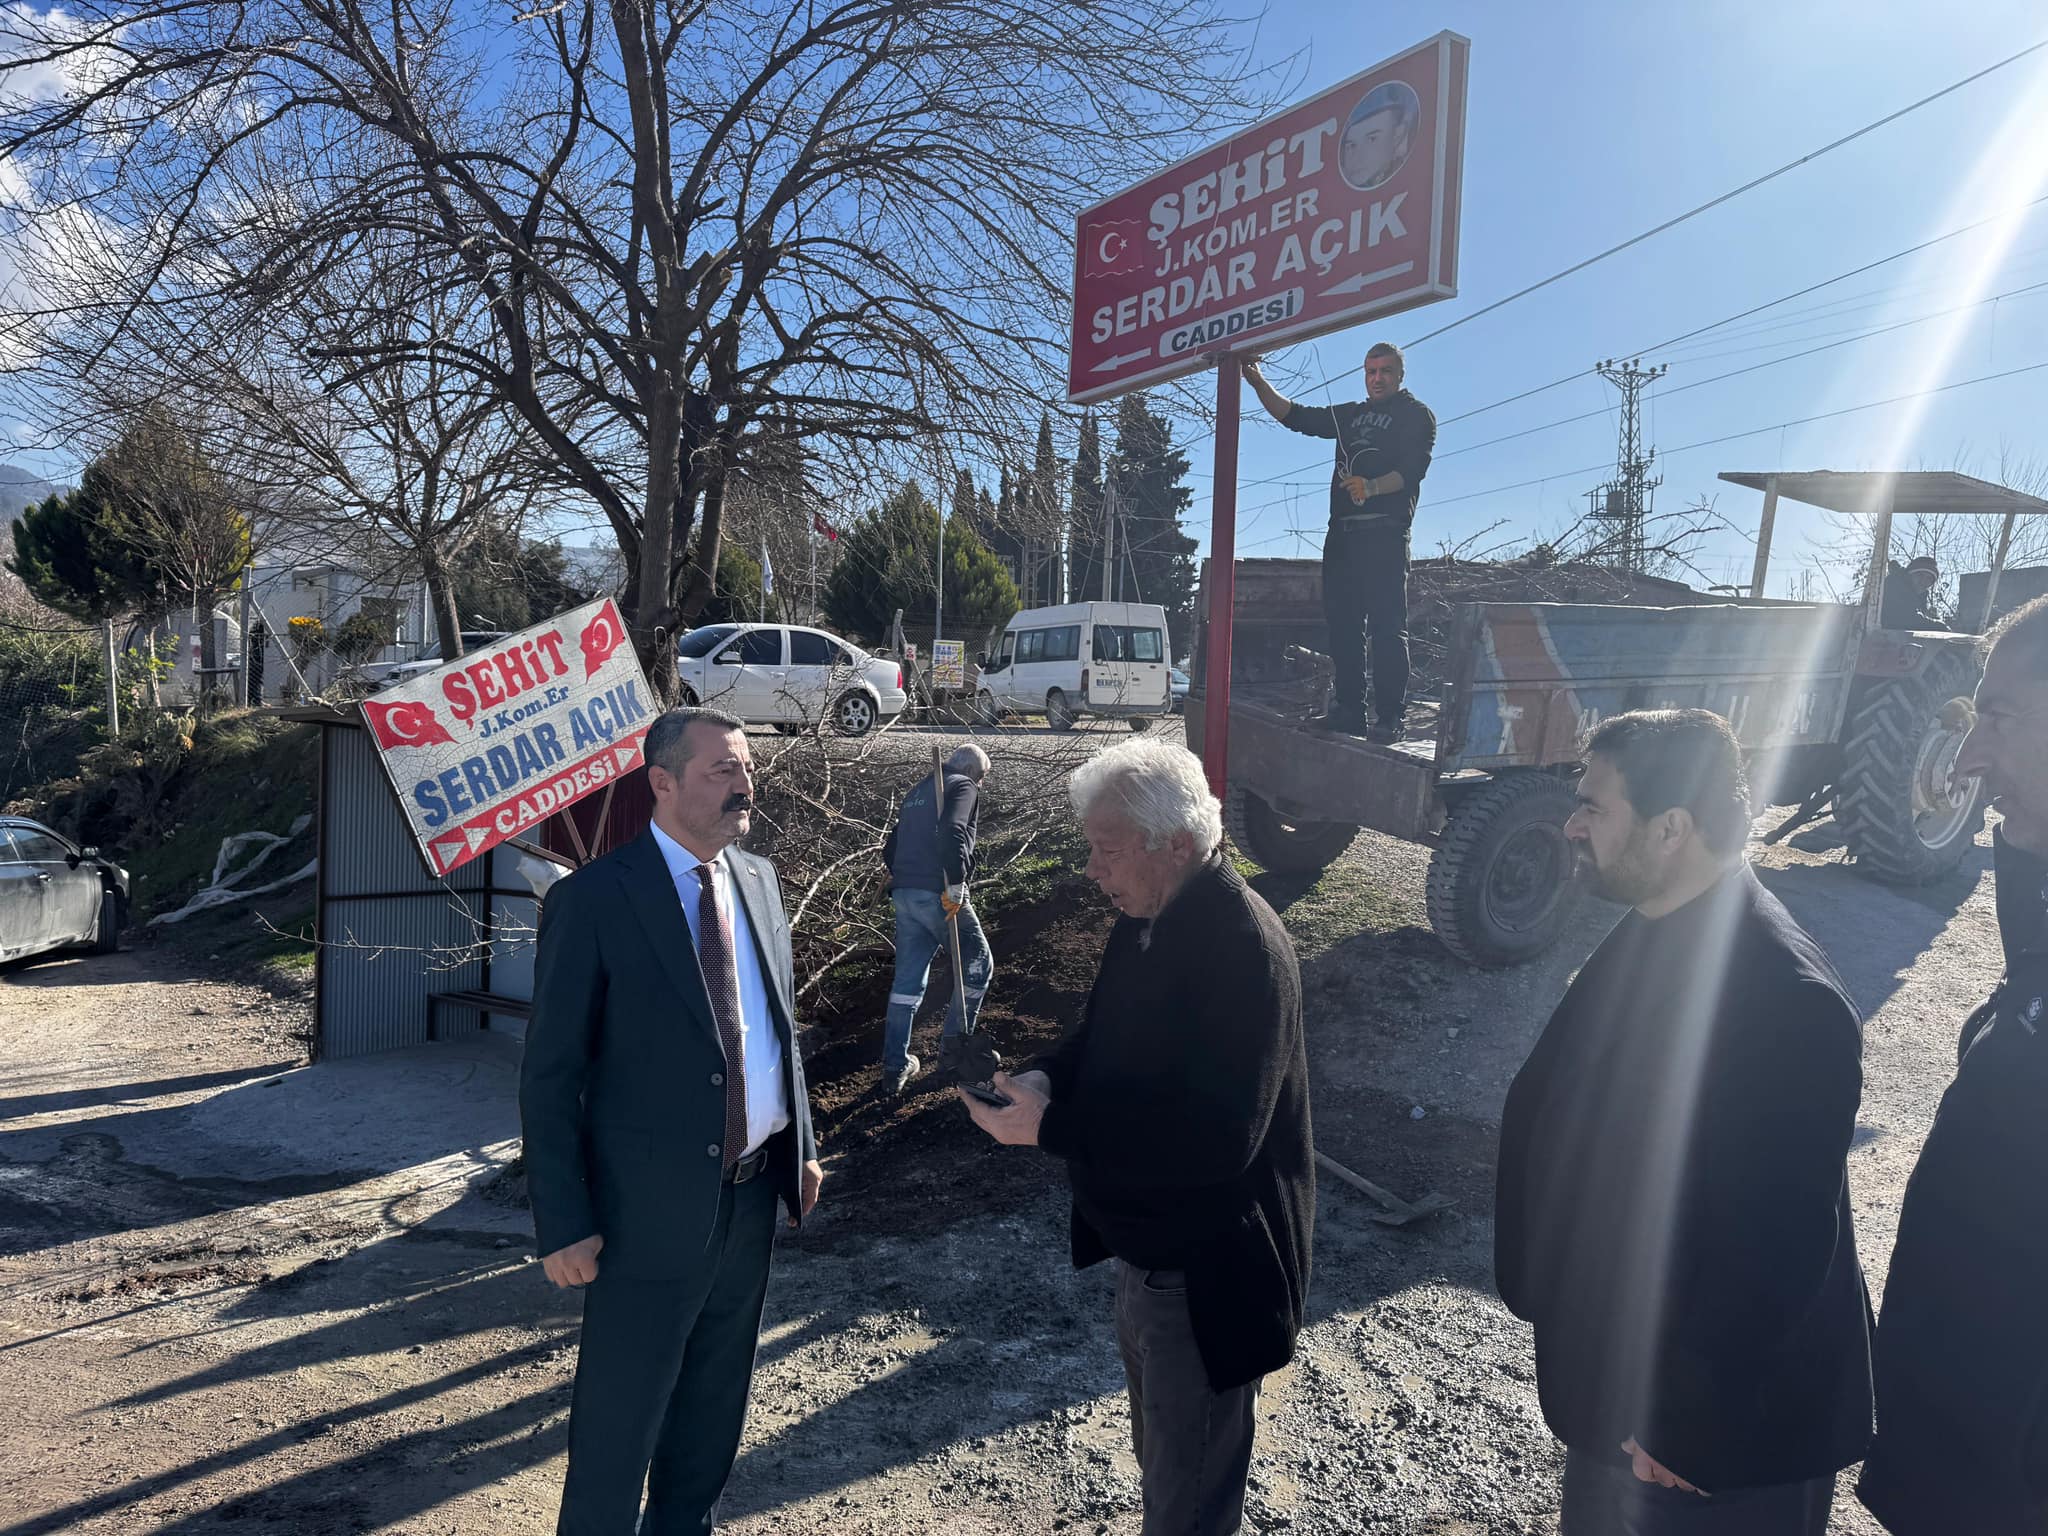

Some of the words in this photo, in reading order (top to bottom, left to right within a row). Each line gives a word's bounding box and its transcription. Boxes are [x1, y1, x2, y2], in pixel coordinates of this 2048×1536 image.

[1090, 251, 1257, 344] SERDAR
[1271, 192, 1409, 280] AÇIK
[1155, 188, 1319, 277] J.KOM.ER
[1171, 290, 1294, 352] CADDESİ
[414, 722, 566, 827] SERDAR
[567, 679, 648, 745] AÇIK
[480, 686, 569, 738] J.Kom.Er
